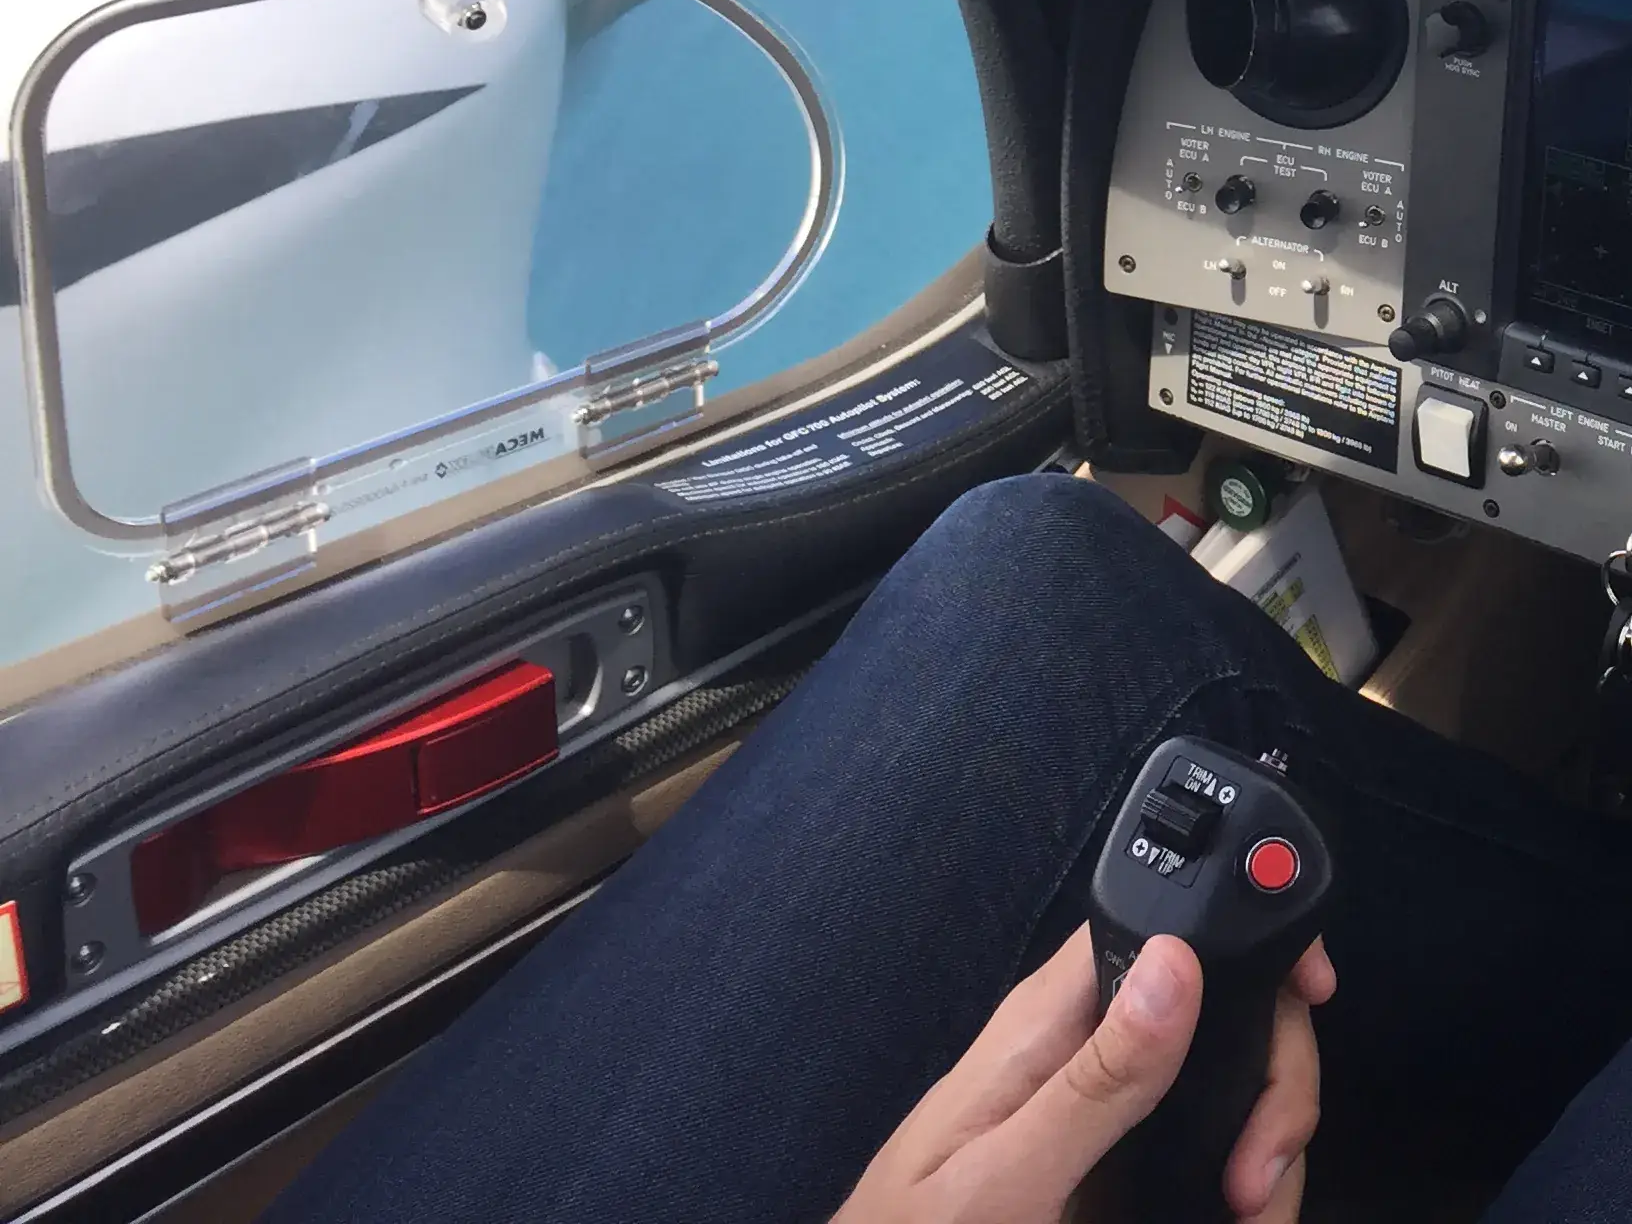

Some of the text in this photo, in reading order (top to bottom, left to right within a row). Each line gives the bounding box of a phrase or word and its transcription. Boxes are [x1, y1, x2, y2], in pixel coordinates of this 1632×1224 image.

[1219, 128, 1251, 142] ENGINE
[1336, 149, 1369, 163] ENGINE
[1274, 165, 1296, 178] TEST
[1362, 170, 1392, 184] VOTER
[1251, 236, 1309, 254] ALTERNATOR
[1439, 279, 1460, 294] ALT
[1430, 367, 1455, 382] PITOT
[1531, 413, 1567, 433] MASTER
[1550, 406, 1610, 434] LEFT ENGINE
[701, 399, 879, 468] Limitations for Autopilot
[1598, 436, 1625, 452] START
[1187, 763, 1213, 784] TRIM
[1159, 847, 1186, 869] TRIM
